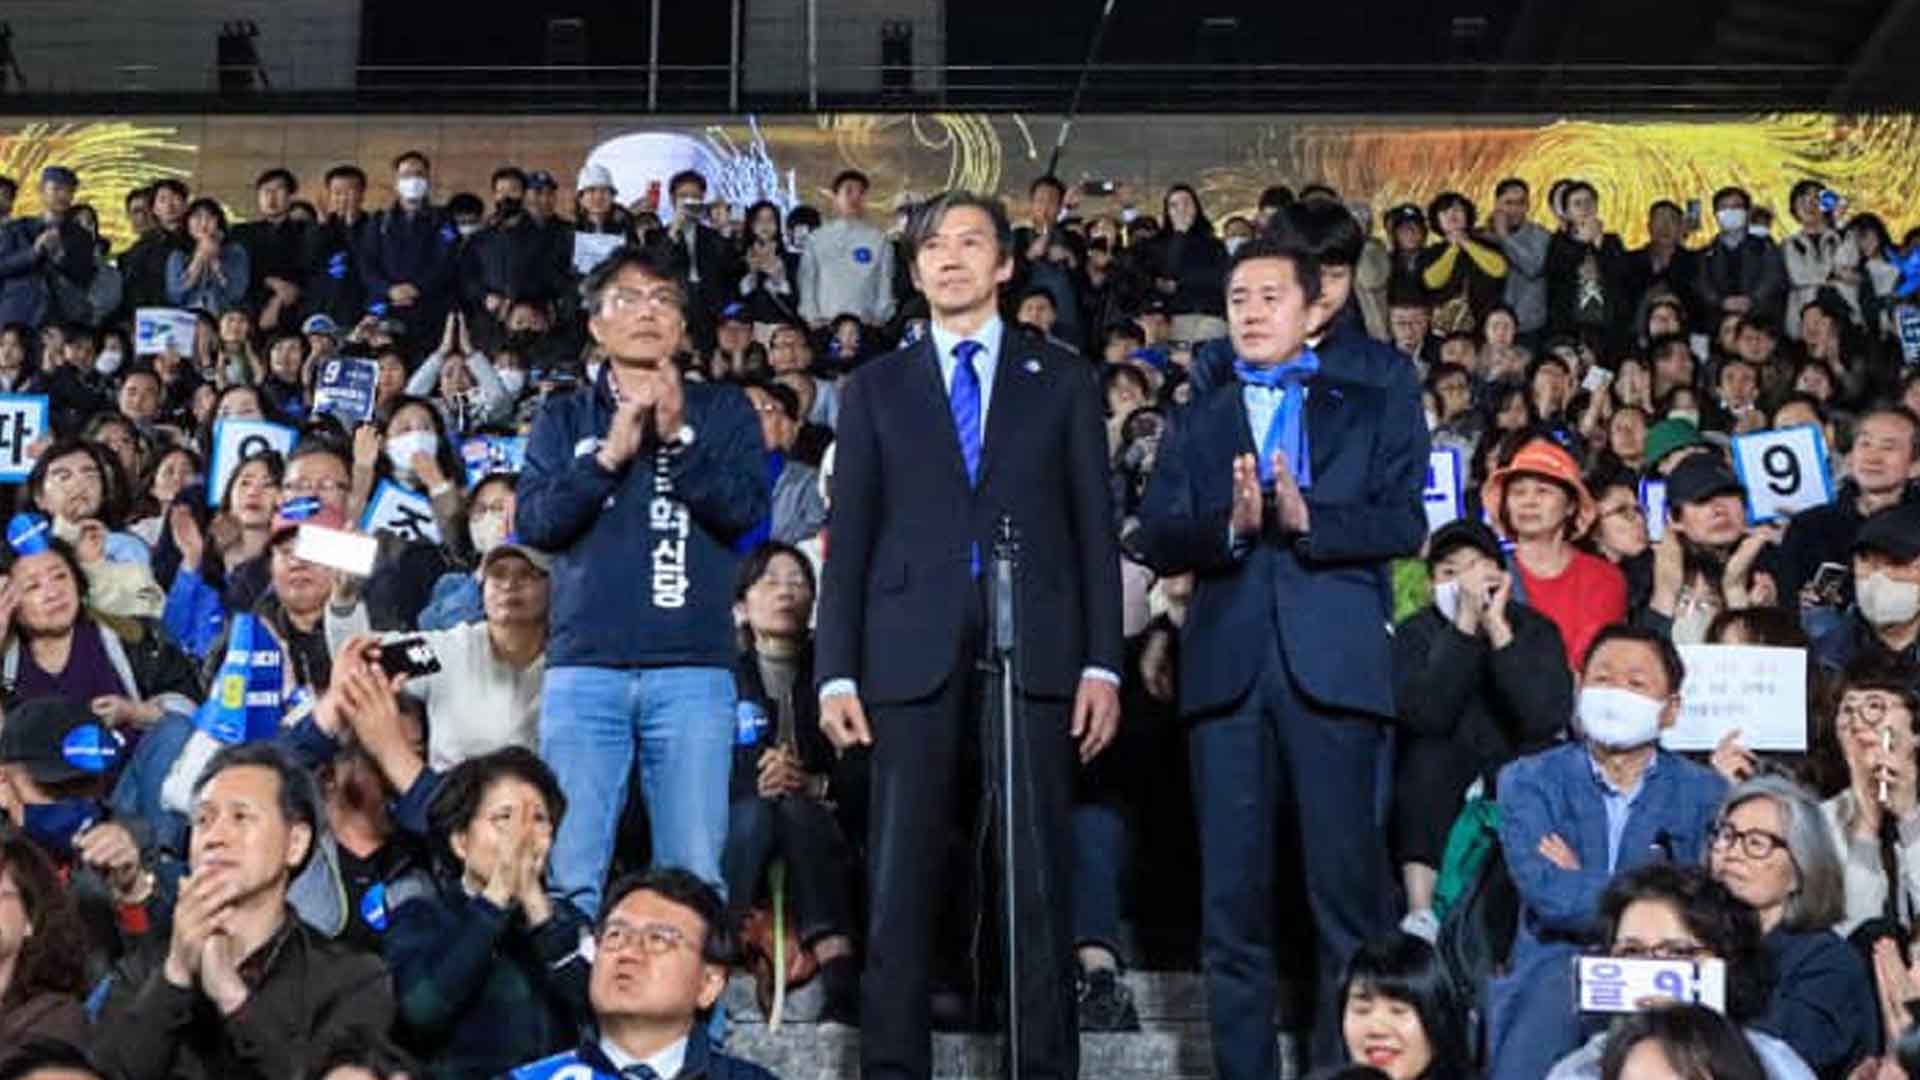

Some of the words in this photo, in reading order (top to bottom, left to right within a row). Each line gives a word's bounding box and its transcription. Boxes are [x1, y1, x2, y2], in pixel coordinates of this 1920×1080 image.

[323, 360, 342, 384] 9
[1762, 444, 1802, 496] 9
[1584, 962, 1628, 1007] 을
